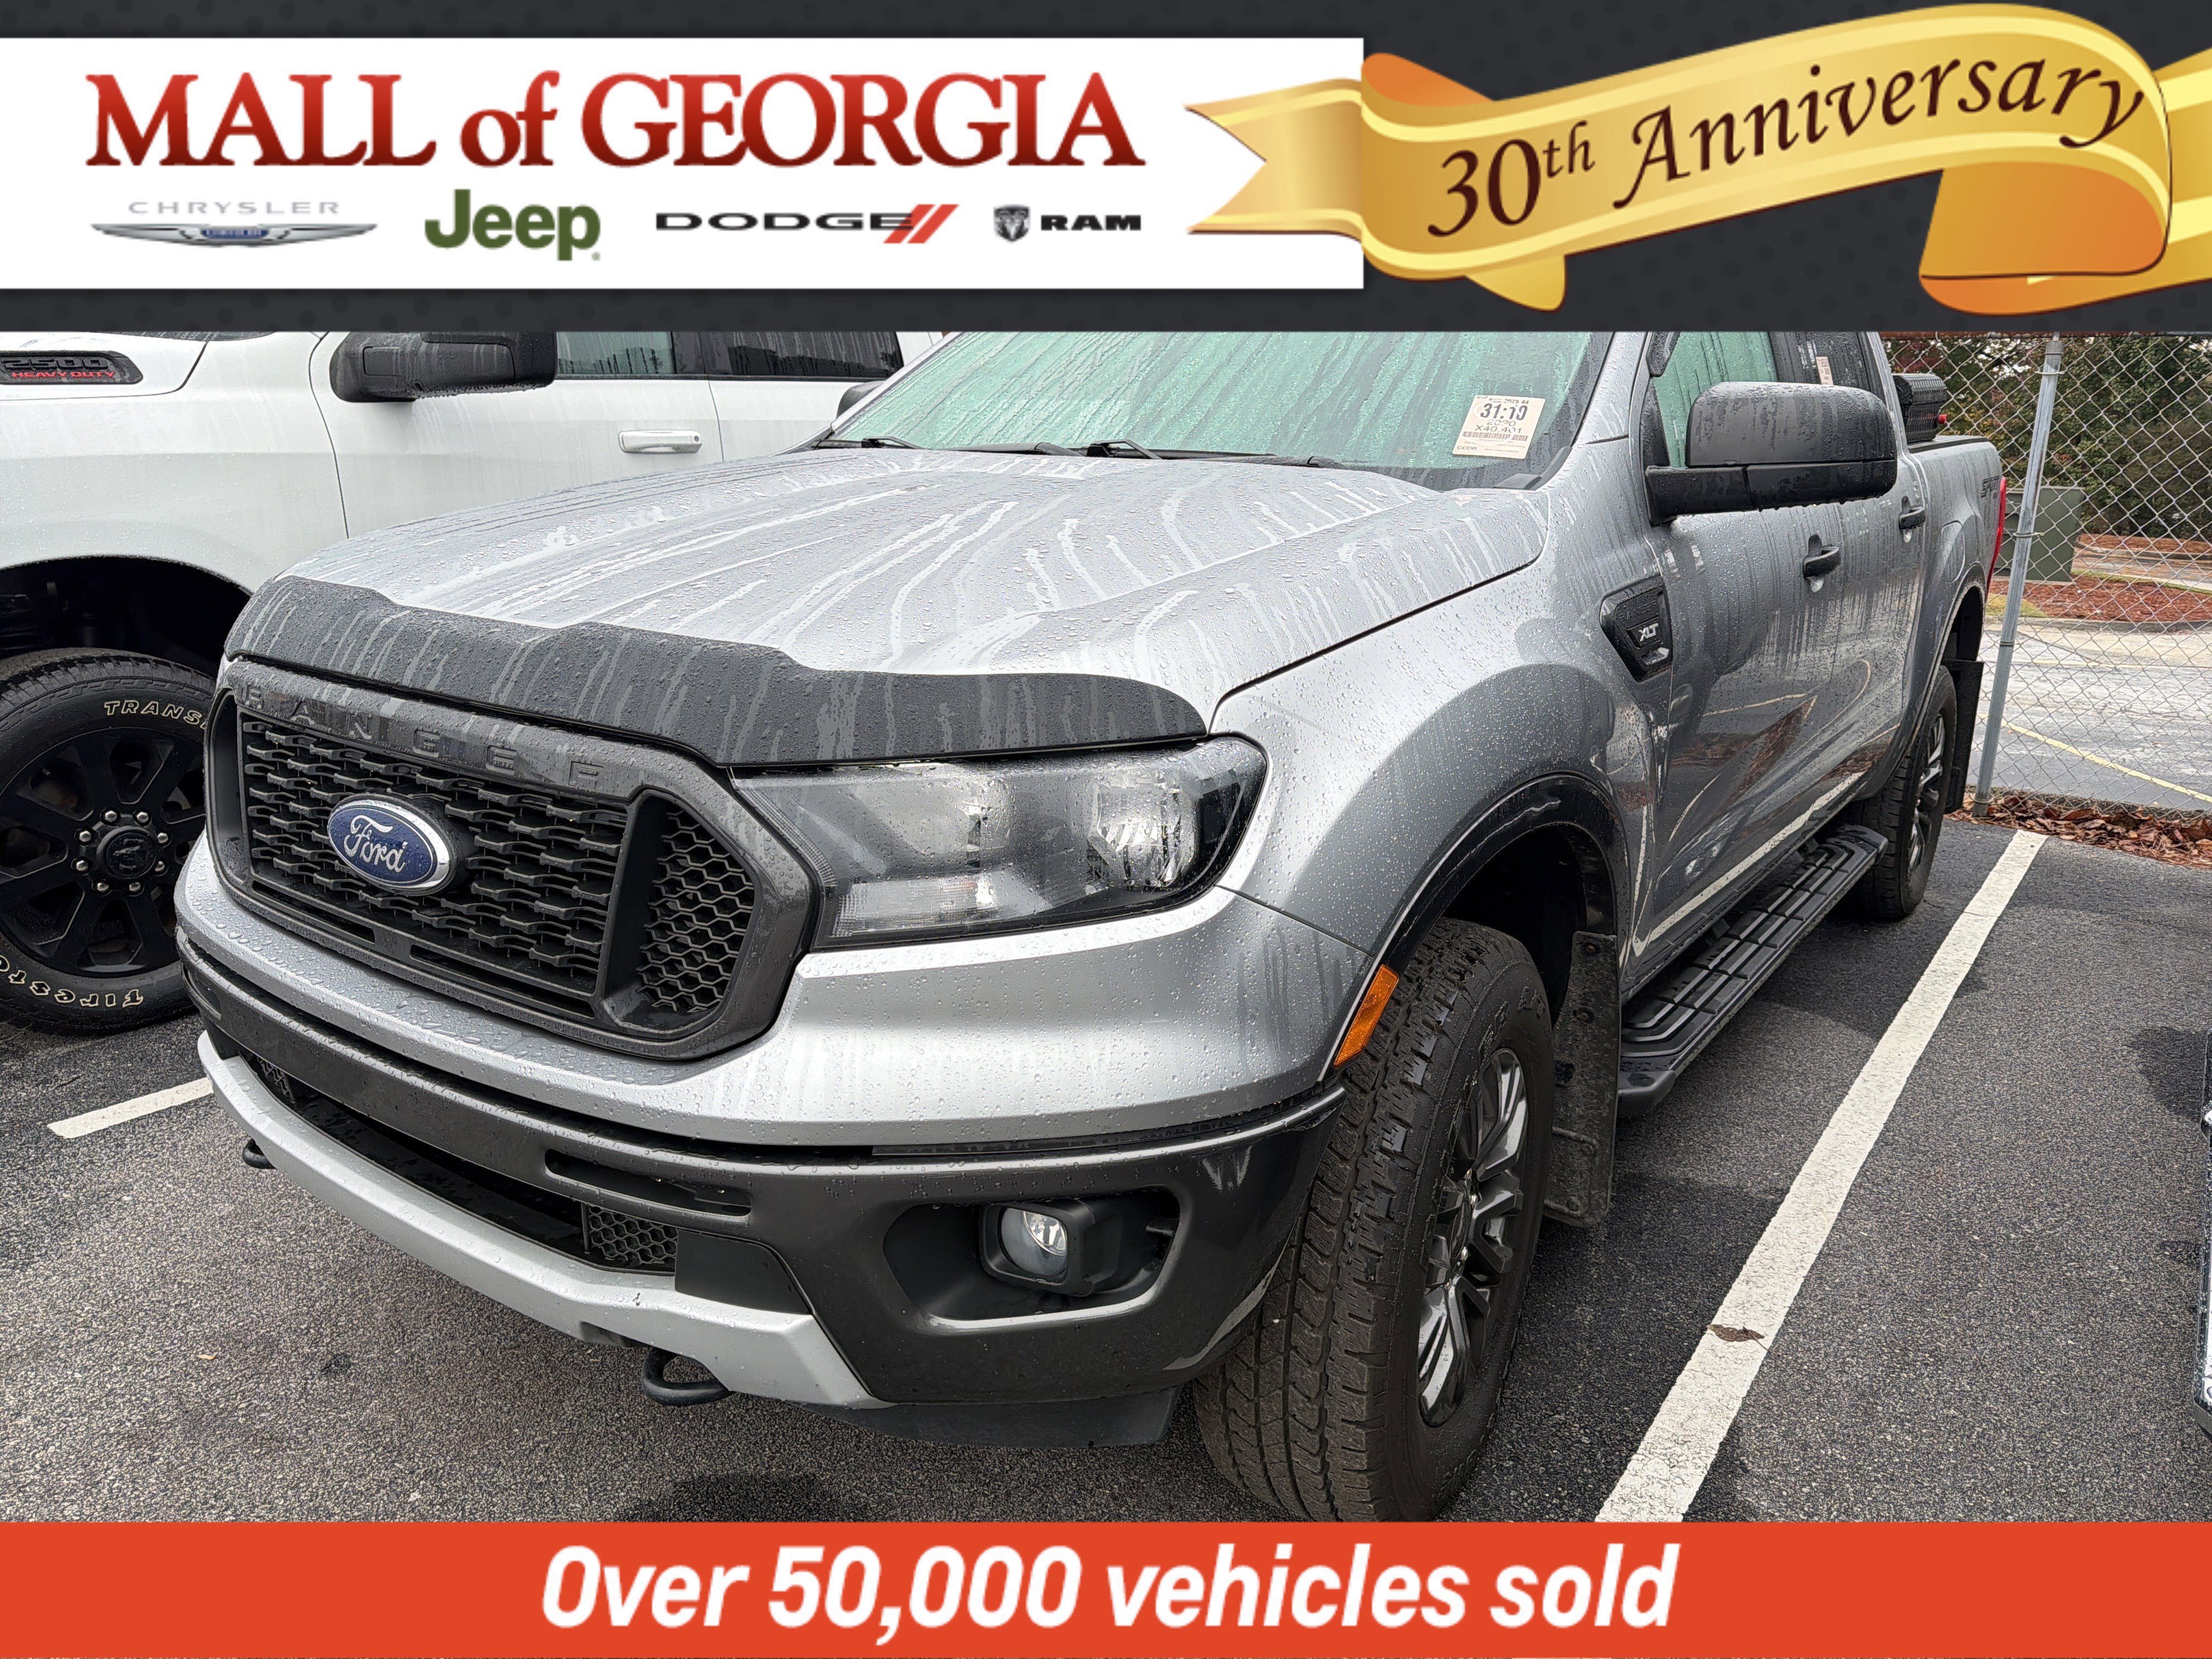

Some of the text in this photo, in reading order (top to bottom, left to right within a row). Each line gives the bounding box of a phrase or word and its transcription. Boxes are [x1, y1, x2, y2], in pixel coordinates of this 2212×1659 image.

[2, 359, 109, 370] 2500
[1637, 623, 1659, 642] XLT
[104, 699, 207, 730] TRANS
[246, 684, 605, 792] RANGER
[344, 815, 408, 872] Ford
